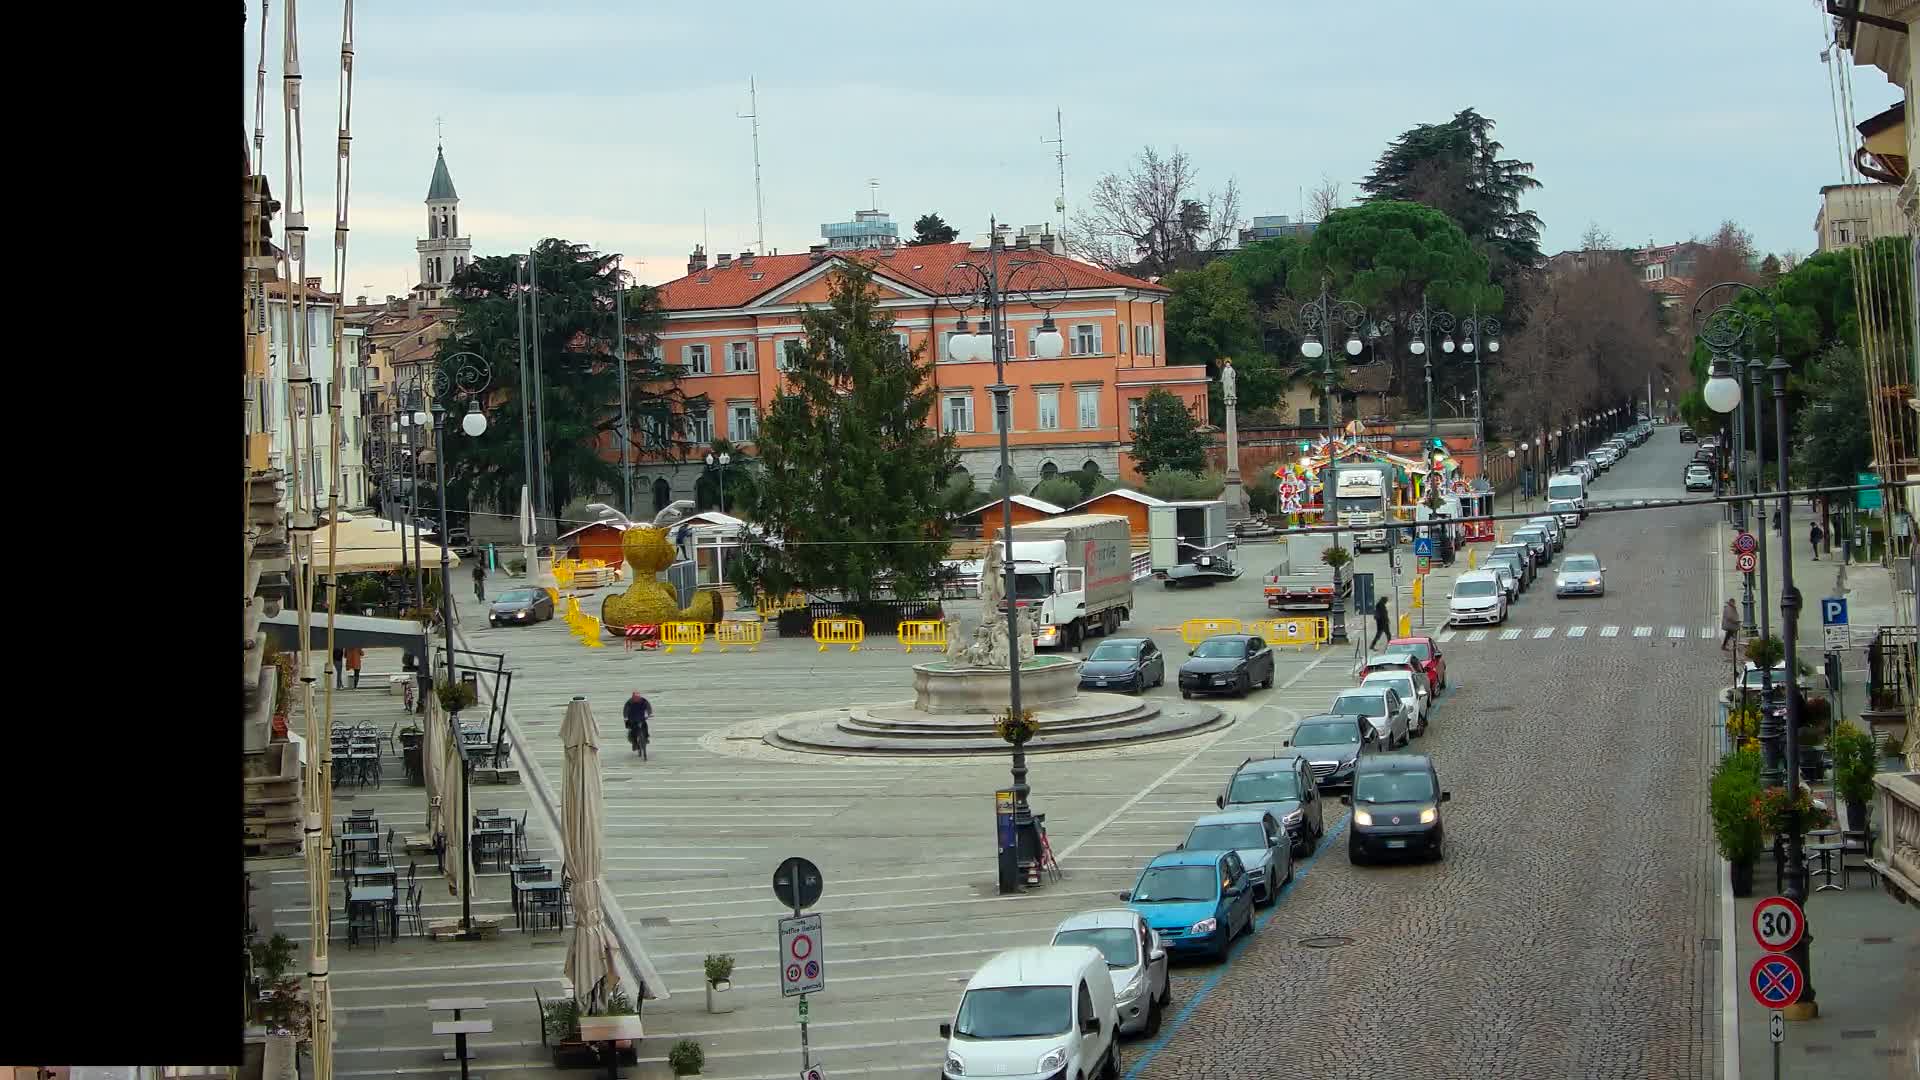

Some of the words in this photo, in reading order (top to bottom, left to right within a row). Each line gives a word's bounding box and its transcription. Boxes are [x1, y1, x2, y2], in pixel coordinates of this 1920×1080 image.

[1743, 557, 1752, 567] 20
[1827, 602, 1842, 622] P
[1762, 911, 1791, 938] 30
